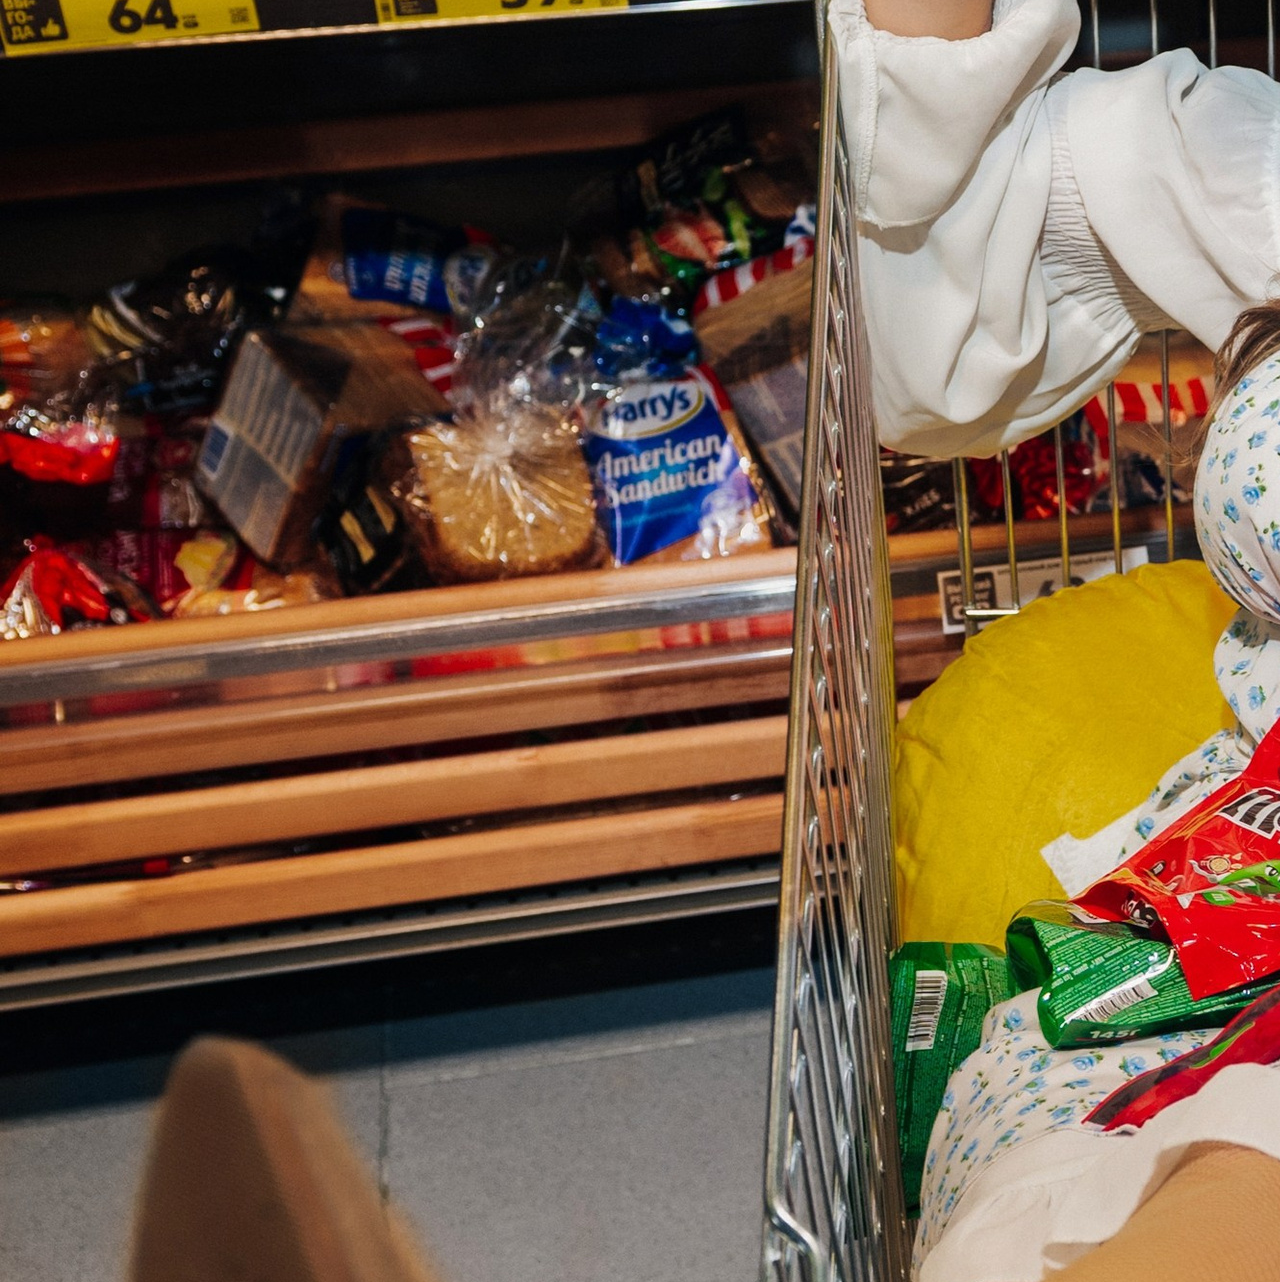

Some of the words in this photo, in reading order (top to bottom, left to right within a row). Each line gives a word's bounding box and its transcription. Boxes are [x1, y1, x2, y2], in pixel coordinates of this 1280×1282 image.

[7, 10, 34, 25] ГО-
[12, 25, 35, 41] ДА
[597, 434, 722, 478] American
[605, 459, 725, 508] Sandwich
[1090, 1027, 1141, 1039] 145г
